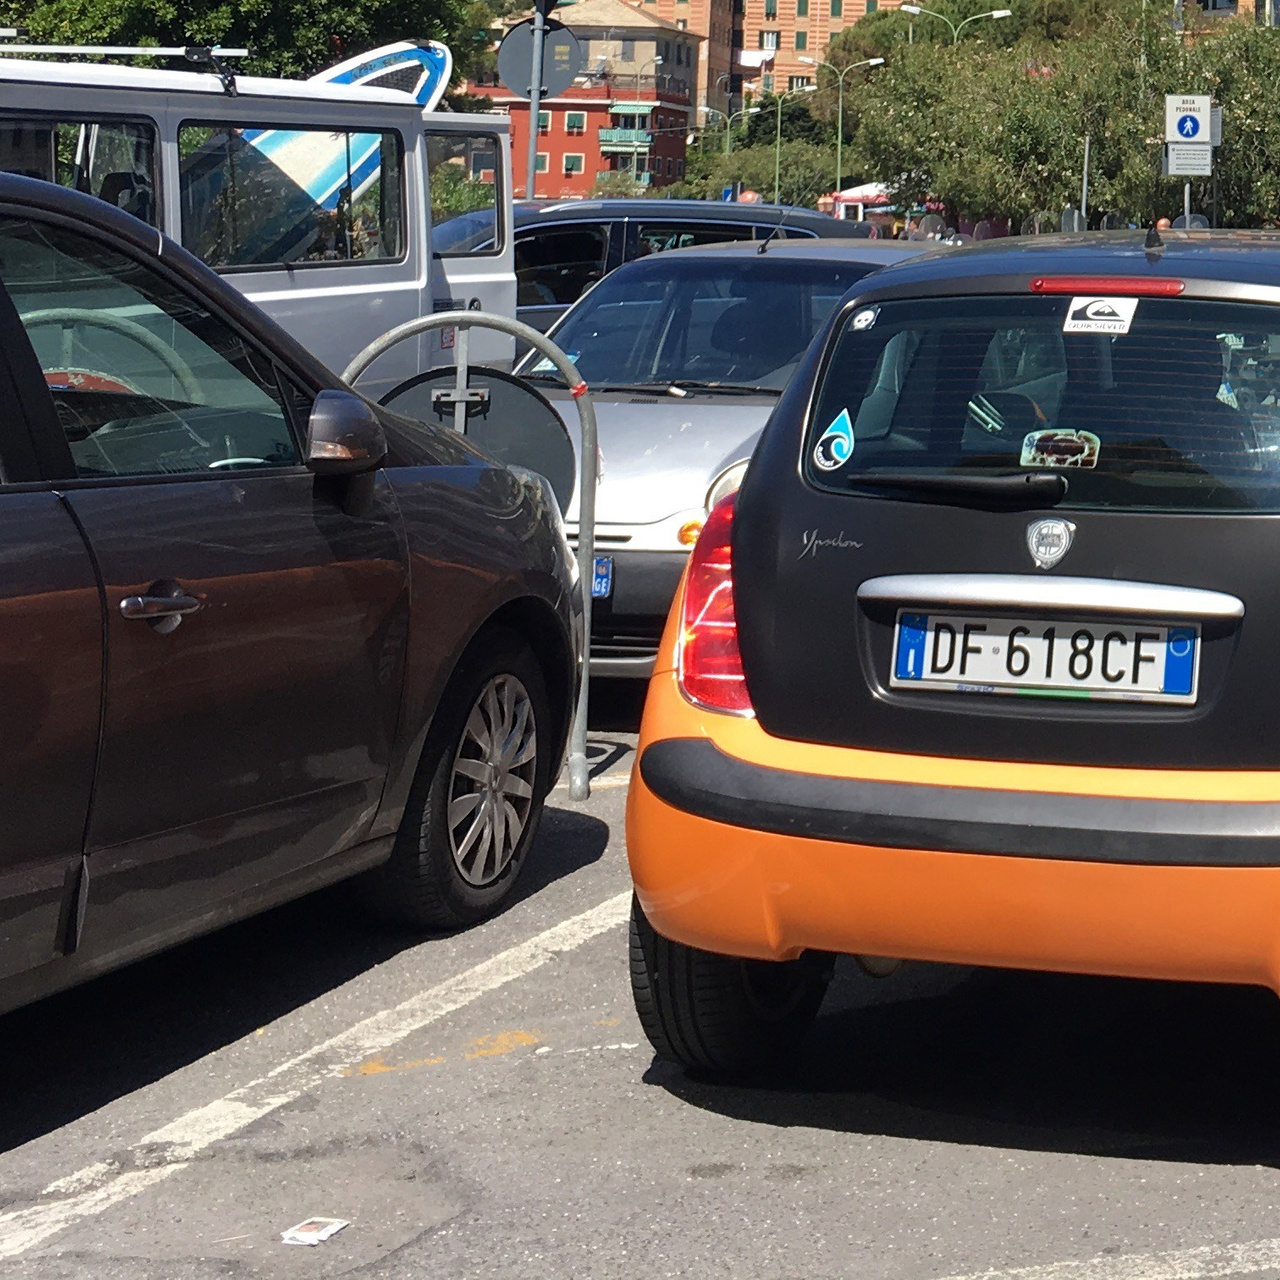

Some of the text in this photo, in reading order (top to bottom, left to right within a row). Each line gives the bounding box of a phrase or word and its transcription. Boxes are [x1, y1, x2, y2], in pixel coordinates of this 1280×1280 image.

[1067, 322, 1126, 331] QUIKSILVER
[594, 578, 607, 595] GE
[929, 622, 1161, 685] DF 618CF
